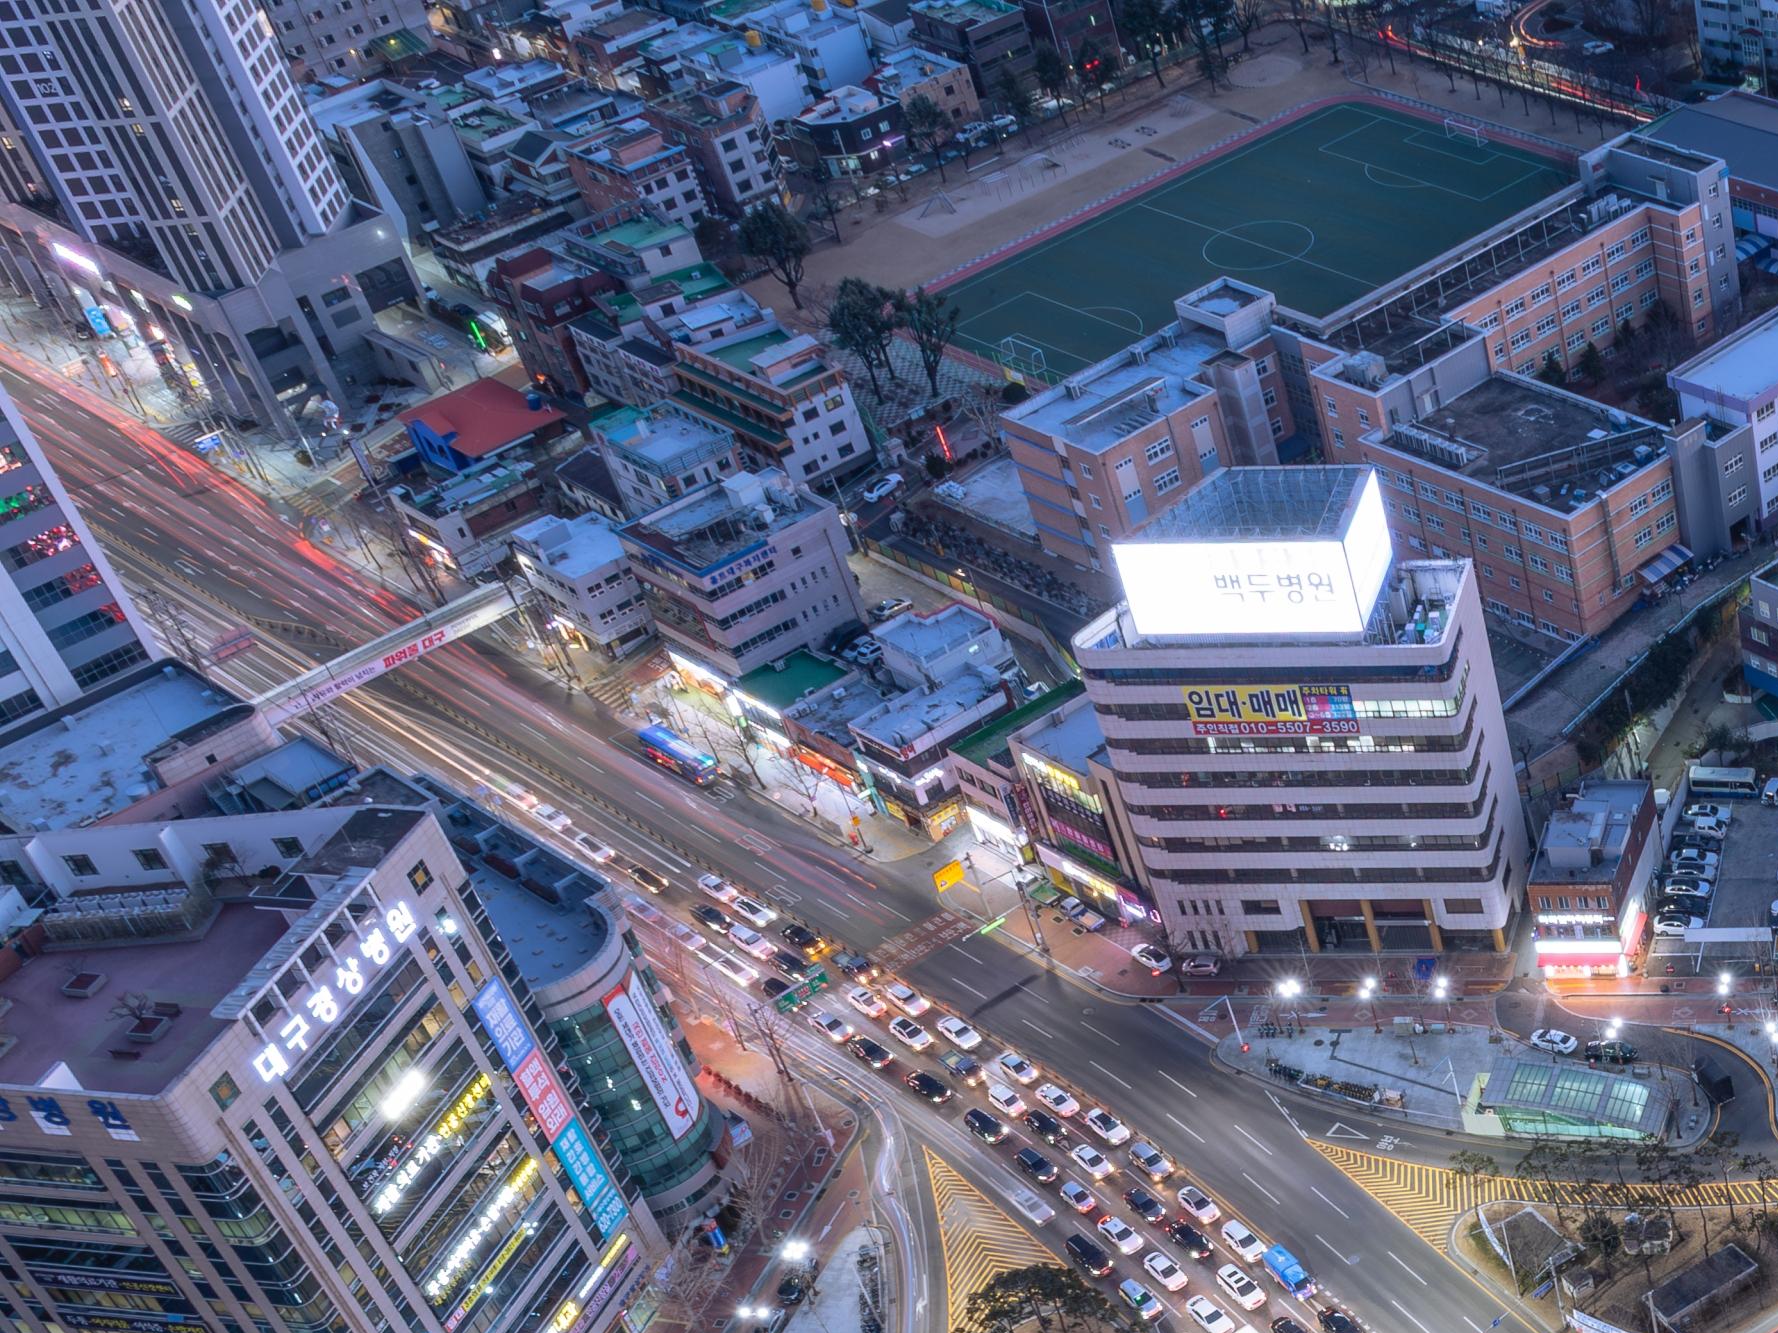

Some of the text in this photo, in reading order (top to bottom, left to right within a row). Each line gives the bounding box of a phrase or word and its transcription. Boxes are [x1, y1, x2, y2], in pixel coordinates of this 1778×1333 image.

[1214, 572, 1337, 604] 백두병원
[422, 630, 446, 650] 대구
[1188, 689, 1302, 719] 임대·매매
[1240, 721, 1359, 734] 010-5507-3590
[253, 901, 417, 1083] 대구경상병원
